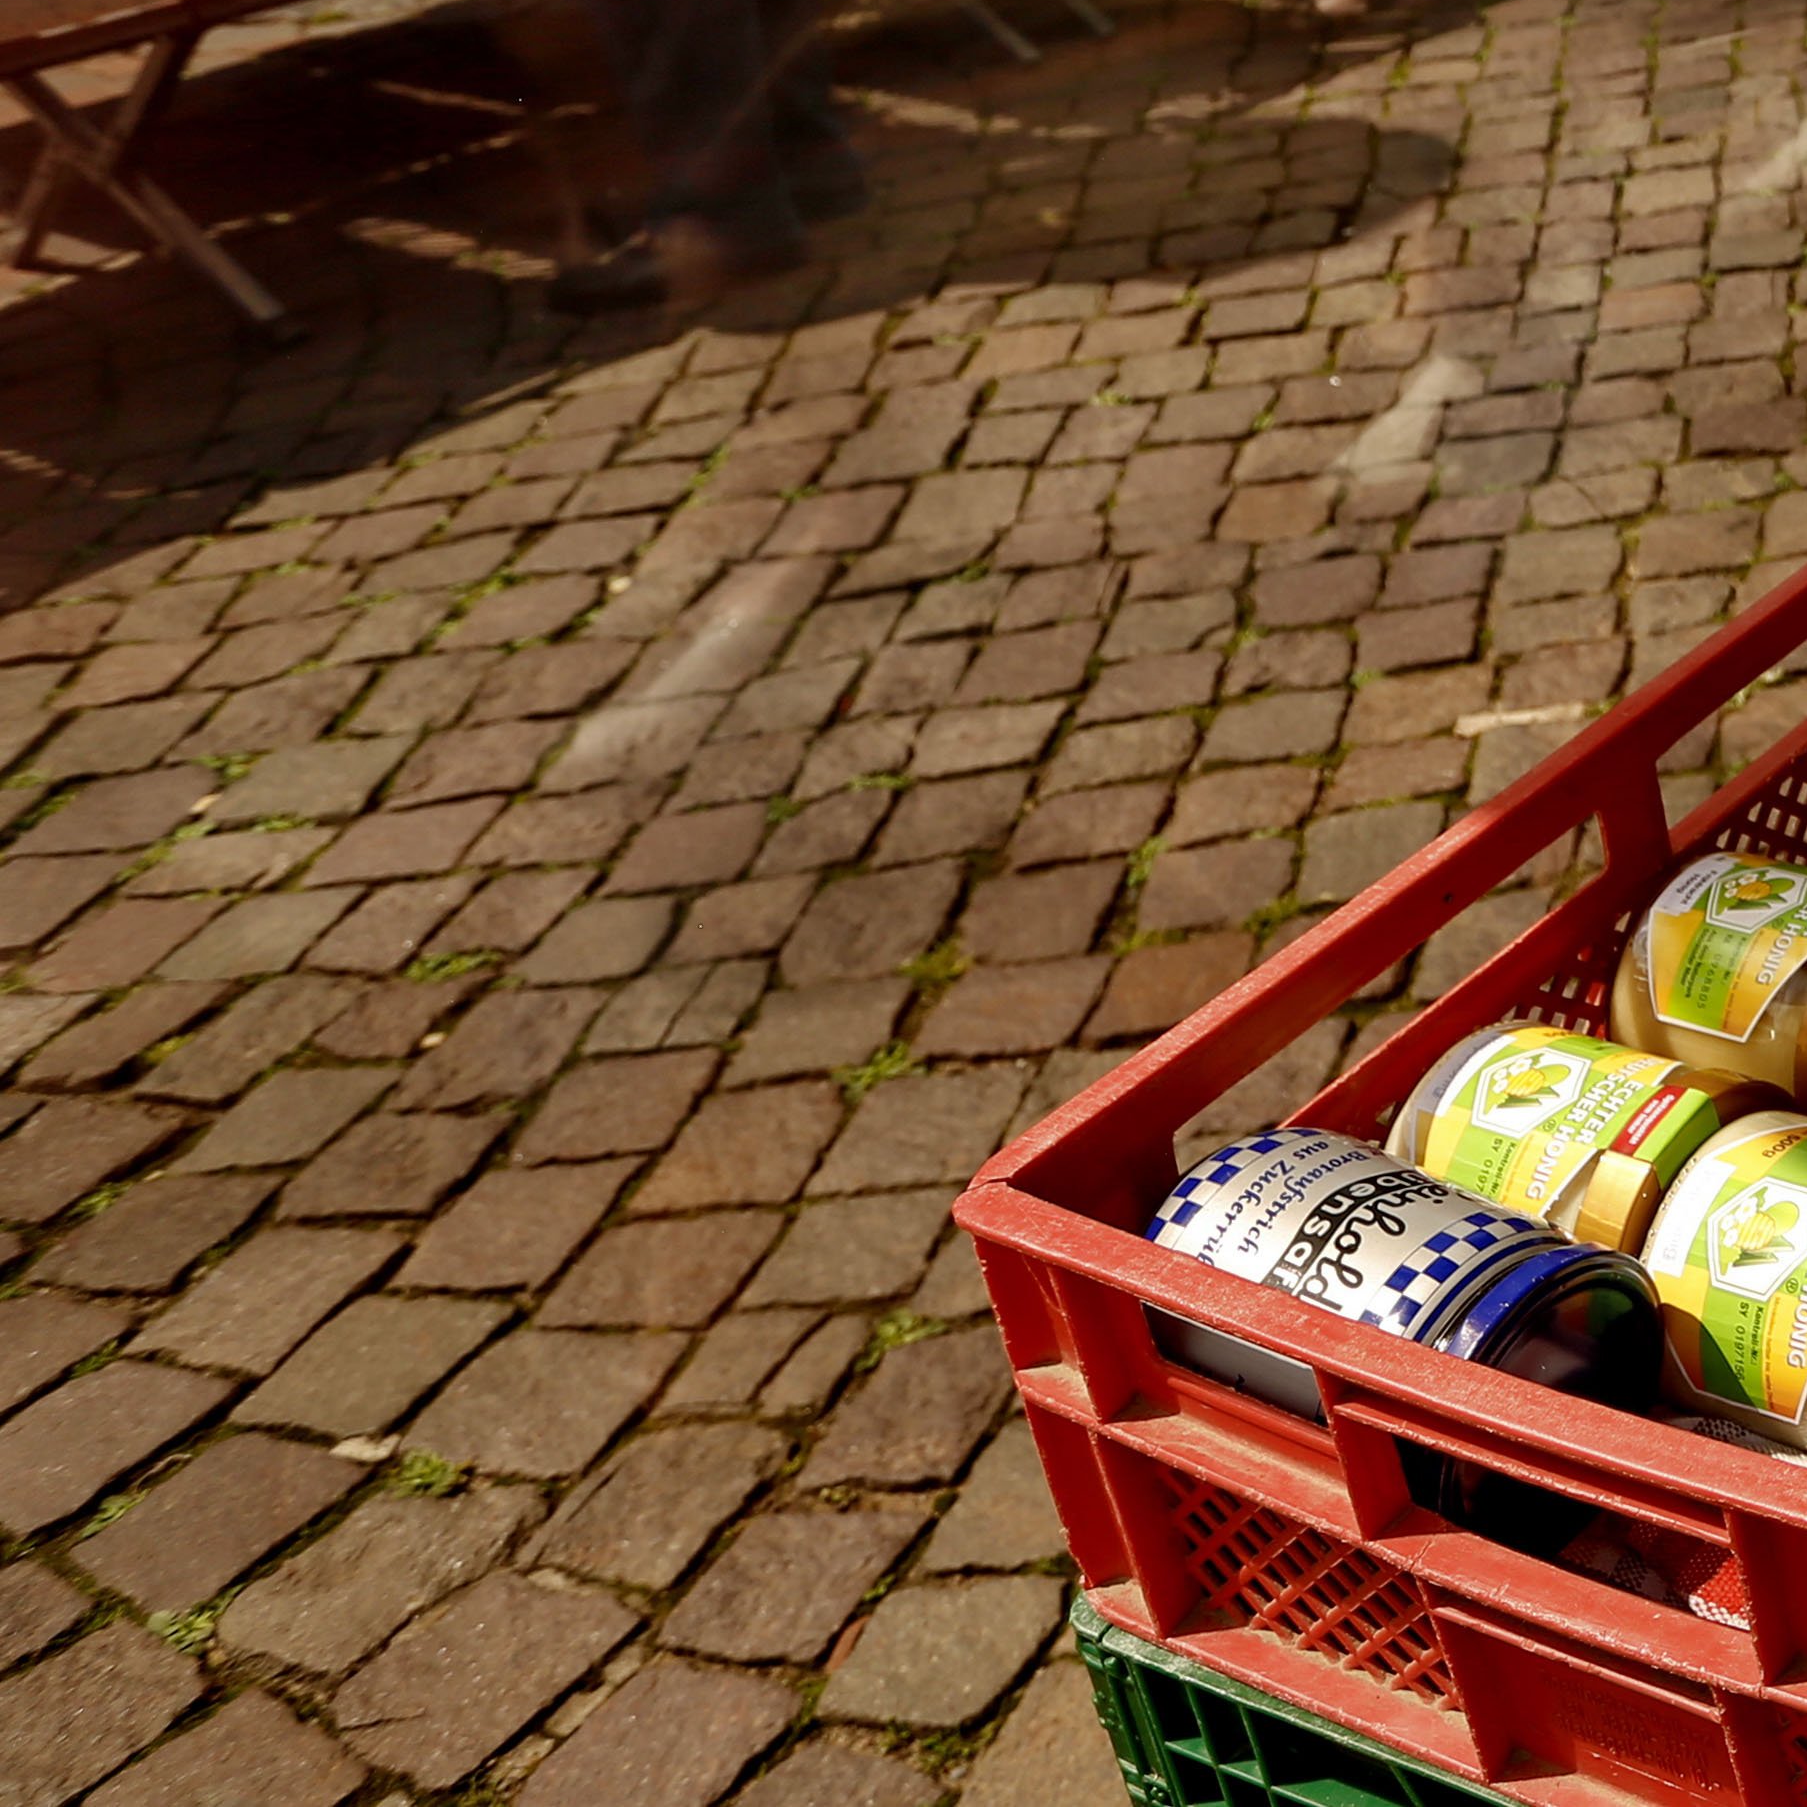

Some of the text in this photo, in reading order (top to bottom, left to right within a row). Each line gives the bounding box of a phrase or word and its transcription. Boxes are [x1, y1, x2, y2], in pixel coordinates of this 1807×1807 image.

[1756, 923, 1800, 986] HONIG
[1575, 1079, 1645, 1145] ECHTER
[1293, 1139, 1330, 1161] aus
[1525, 1123, 1575, 1201] HONIG
[1237, 1148, 1364, 1258] Brotaufstrich
